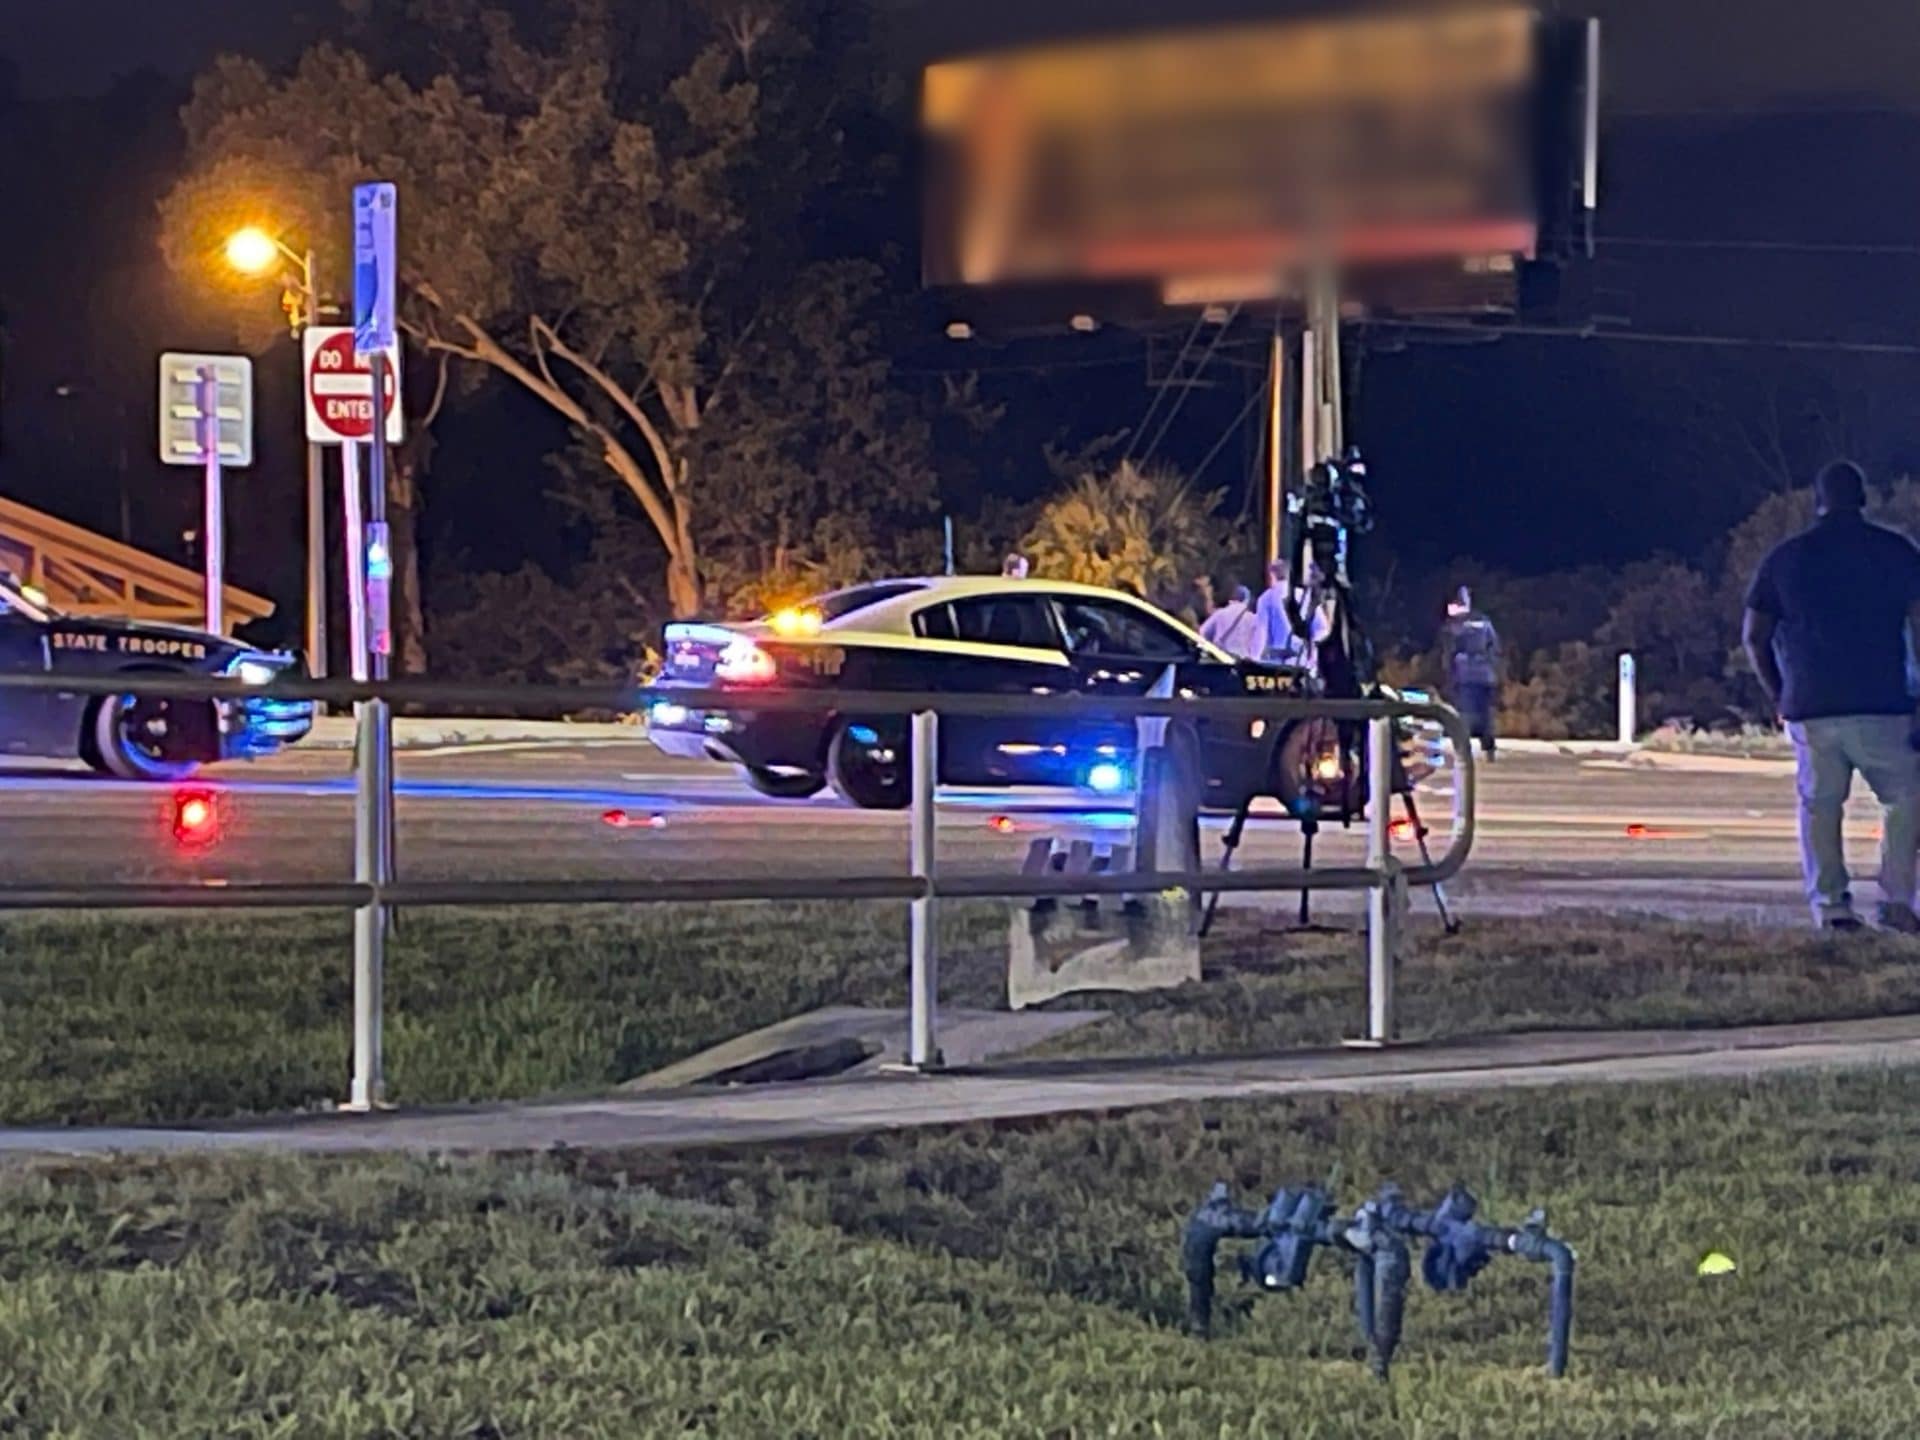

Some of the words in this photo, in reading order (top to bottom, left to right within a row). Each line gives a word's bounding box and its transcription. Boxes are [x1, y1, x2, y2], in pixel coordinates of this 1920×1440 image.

[319, 350, 342, 369] DO
[53, 633, 107, 651] STATE
[118, 637, 206, 659] TROOPER
